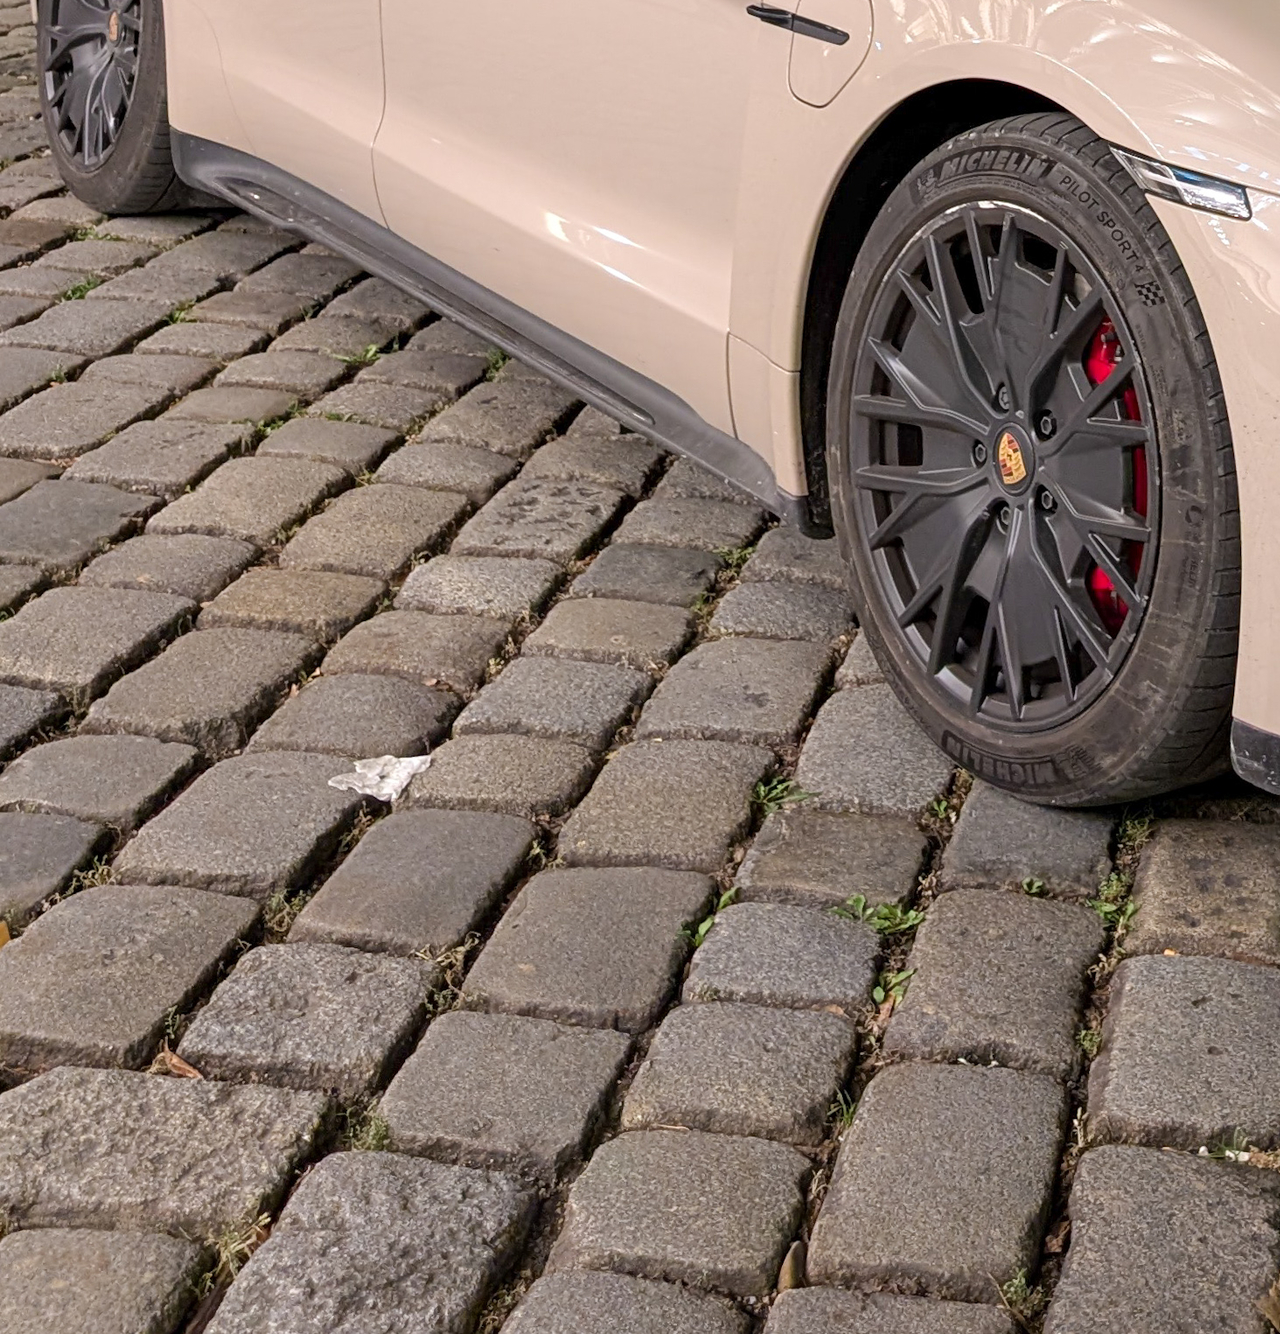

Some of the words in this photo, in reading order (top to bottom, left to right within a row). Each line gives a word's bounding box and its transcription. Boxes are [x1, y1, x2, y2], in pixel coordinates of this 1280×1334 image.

[939, 150, 1050, 181] MICHELIN
[1059, 174, 1100, 210] PILOT
[1096, 210, 1140, 262] SPORT
